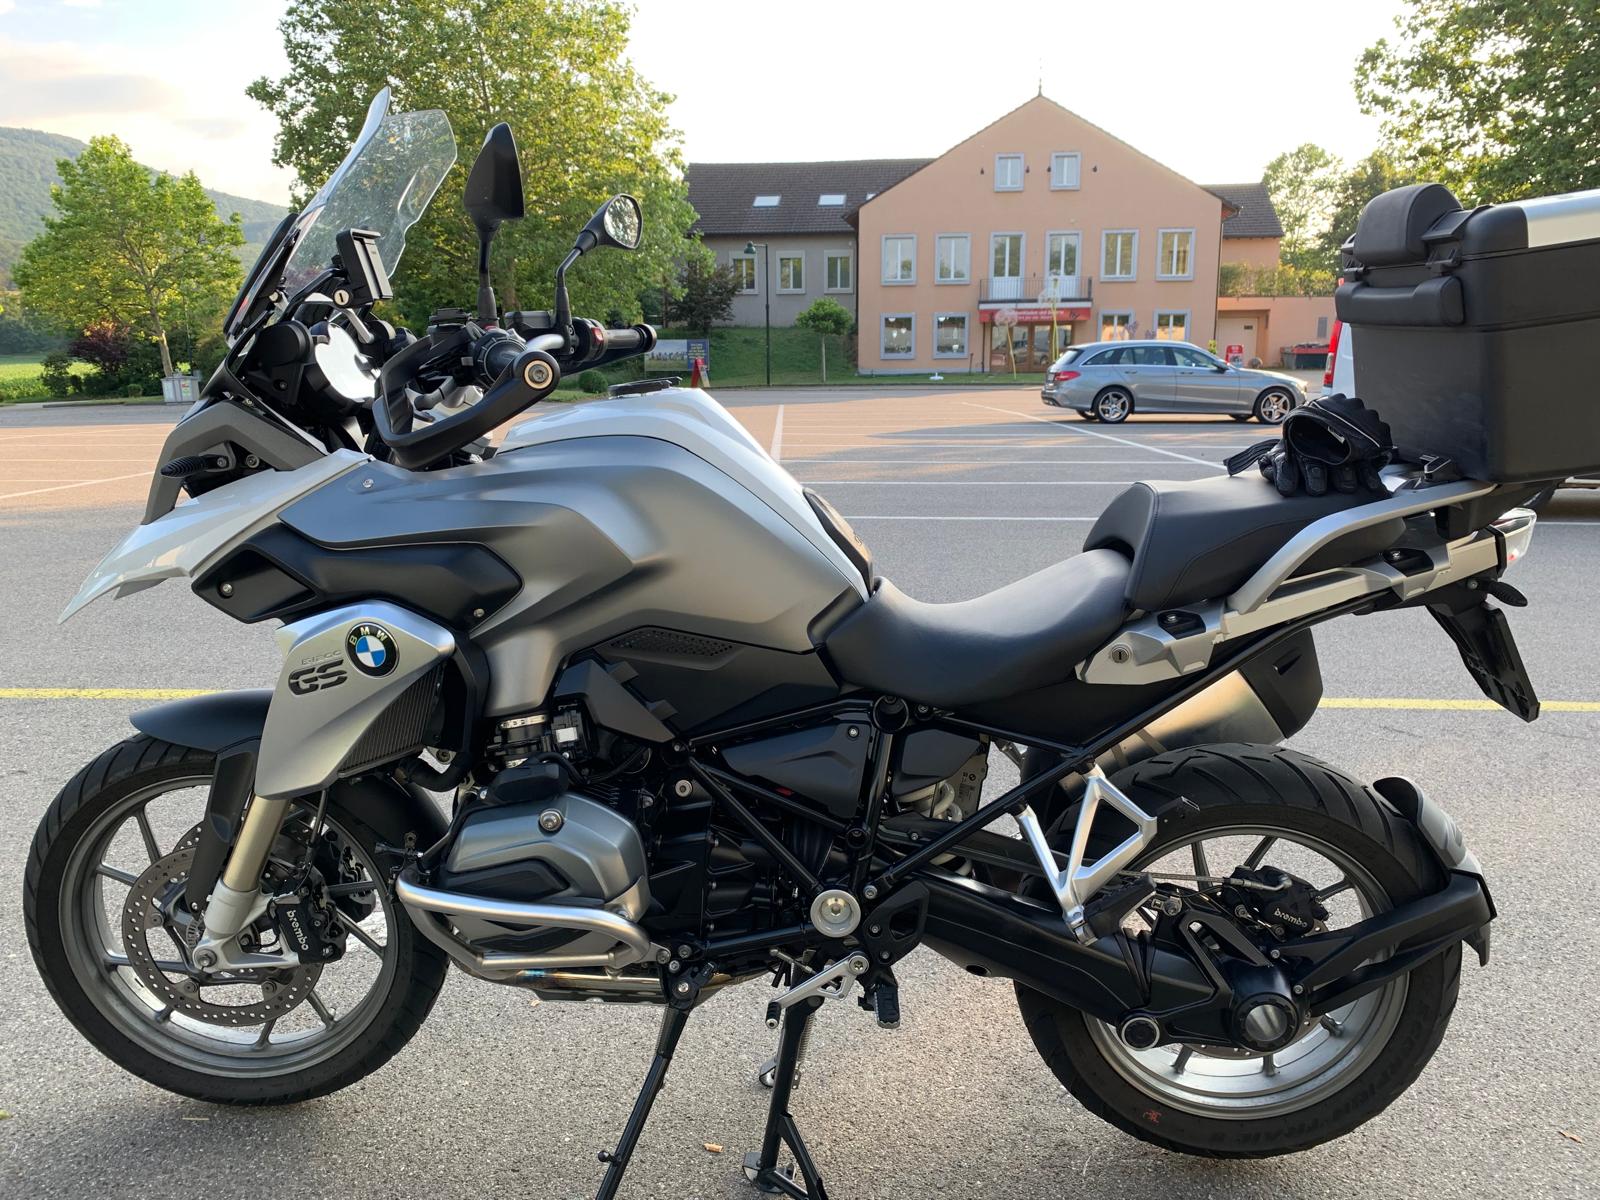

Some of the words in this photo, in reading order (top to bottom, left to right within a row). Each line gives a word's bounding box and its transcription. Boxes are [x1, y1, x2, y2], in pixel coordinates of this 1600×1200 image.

[349, 626, 388, 646] BMW
[288, 659, 347, 695] GS
[286, 910, 309, 951] brembo
[1274, 908, 1308, 928] brembo
